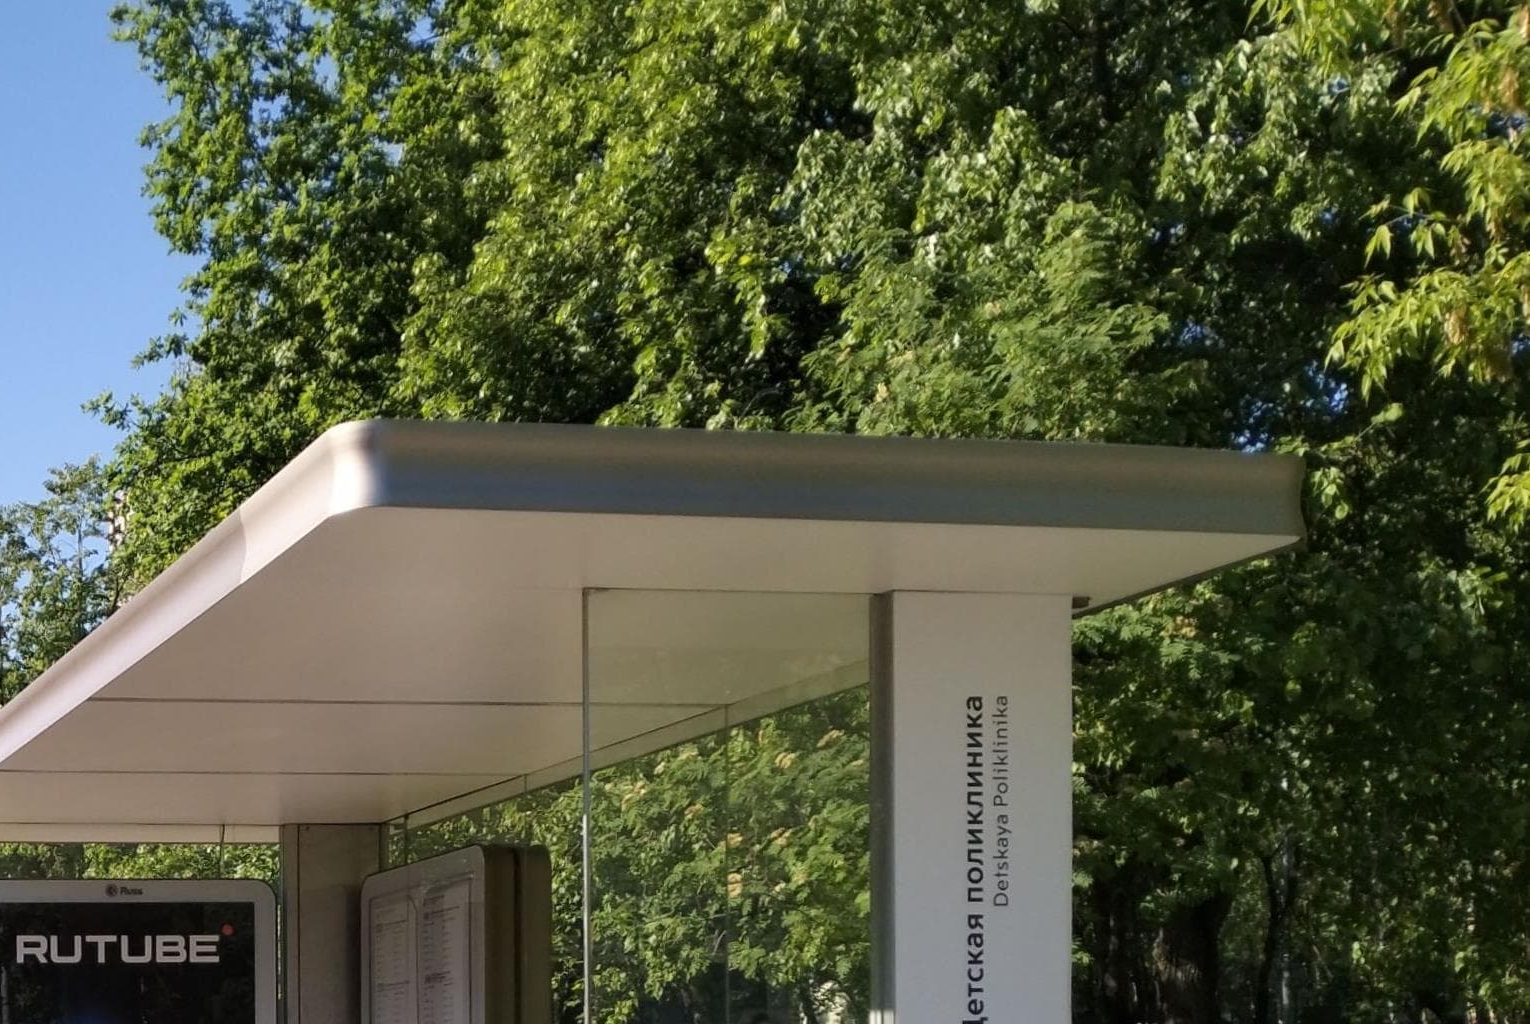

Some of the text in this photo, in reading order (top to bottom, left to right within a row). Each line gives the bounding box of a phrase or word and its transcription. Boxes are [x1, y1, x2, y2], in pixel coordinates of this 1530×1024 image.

[966, 695, 984, 903] поликлиника
[993, 694, 1012, 907] Detskaya Poliklinika
[15, 934, 220, 964] RUTUBE
